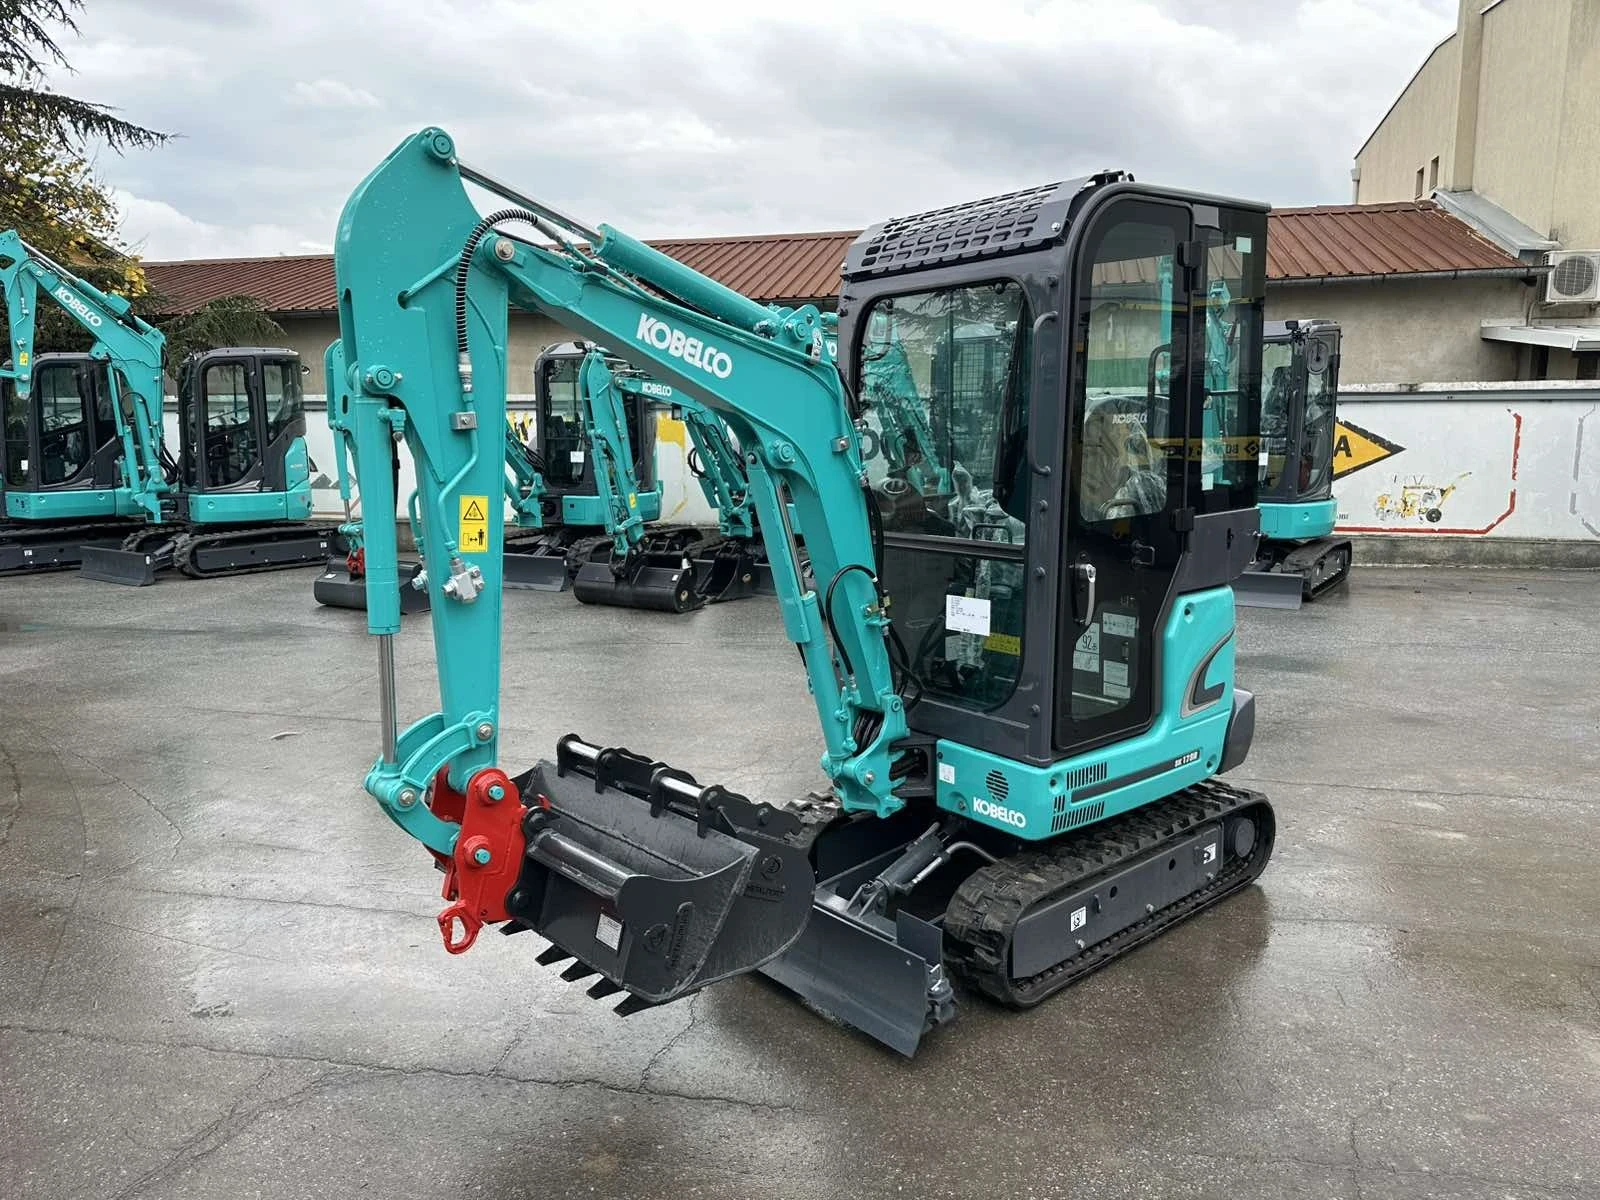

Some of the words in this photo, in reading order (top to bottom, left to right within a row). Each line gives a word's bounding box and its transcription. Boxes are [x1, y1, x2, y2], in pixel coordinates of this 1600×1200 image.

[54, 286, 102, 327] KOBELCO
[636, 312, 732, 379] KOBELCO
[641, 381, 672, 397] KOBELCO
[1081, 634, 1093, 651] 92
[973, 796, 1027, 829] KOBELCO
